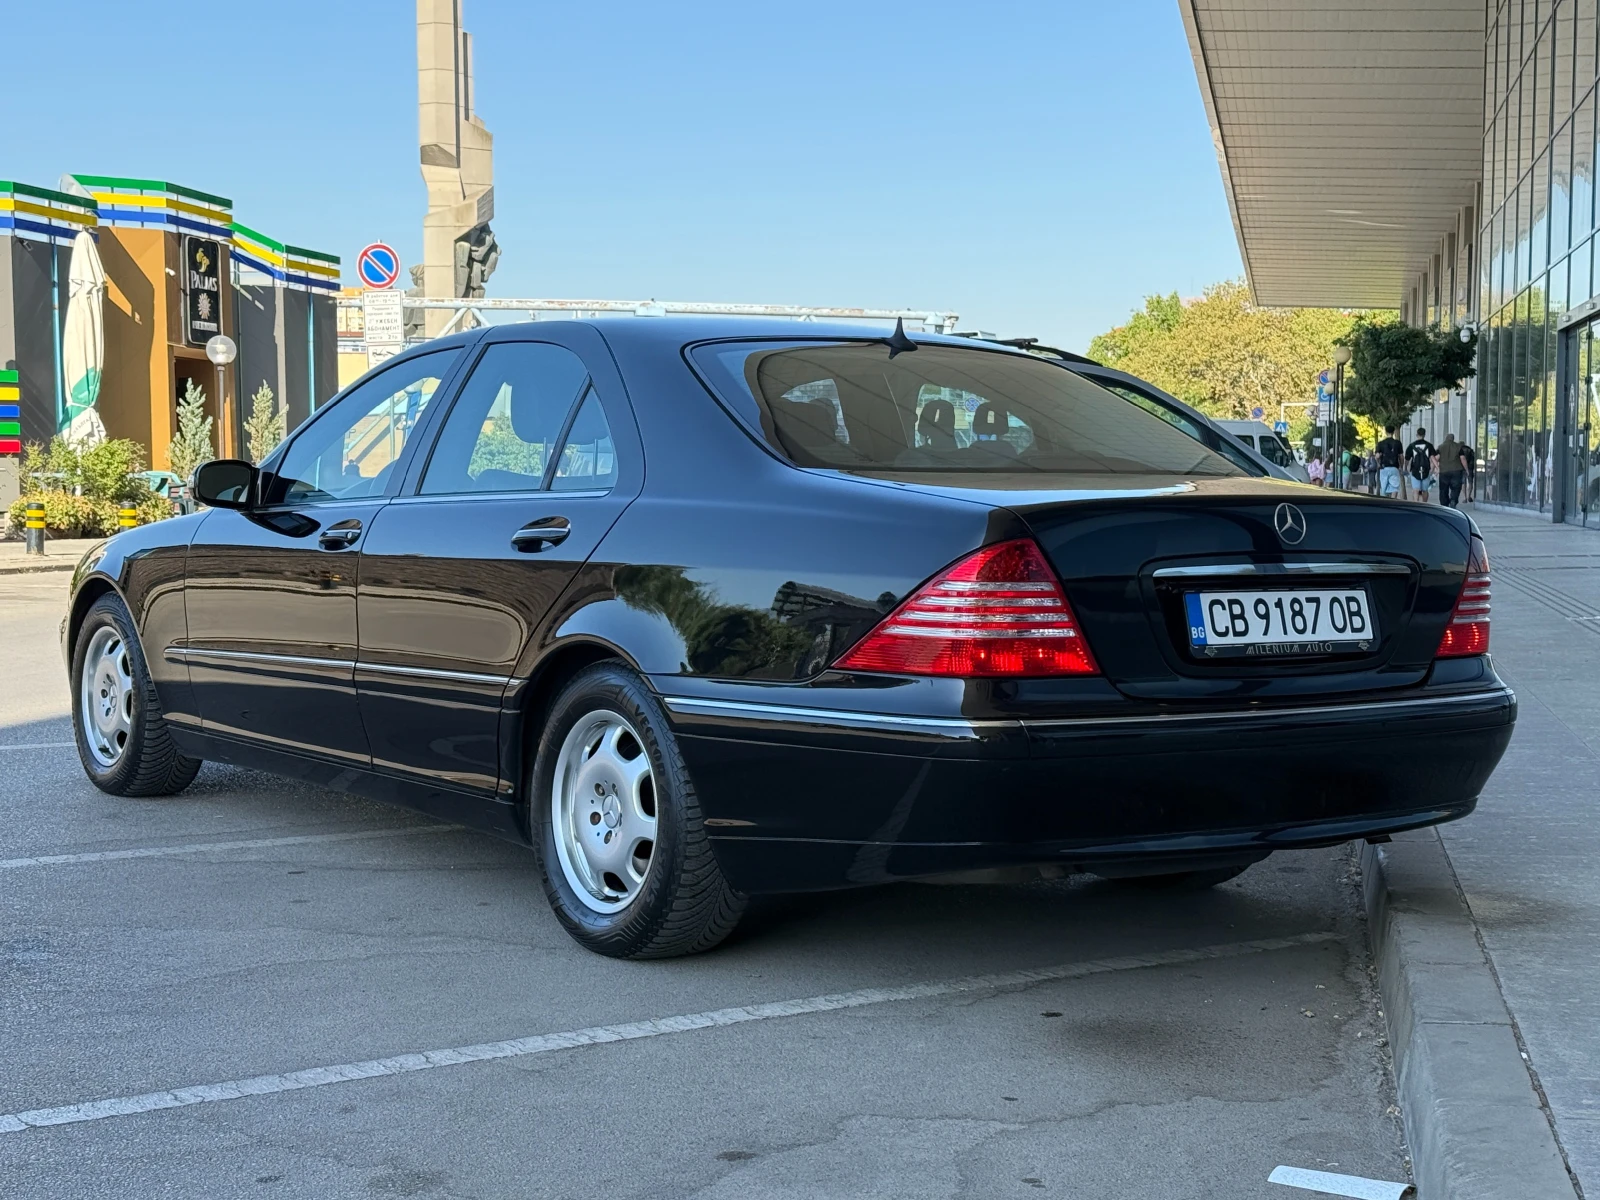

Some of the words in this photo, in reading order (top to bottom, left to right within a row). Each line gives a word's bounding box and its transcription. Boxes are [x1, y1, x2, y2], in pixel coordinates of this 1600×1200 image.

[190, 270, 217, 291] PALMS
[1208, 598, 1250, 638] CB
[1253, 597, 1321, 636] 9187
[1329, 596, 1366, 634] OB
[1191, 626, 1205, 639] BG
[1246, 643, 1300, 655] MILENIUM
[1306, 643, 1333, 652] AUTO
[634, 703, 666, 777] VECTOR
